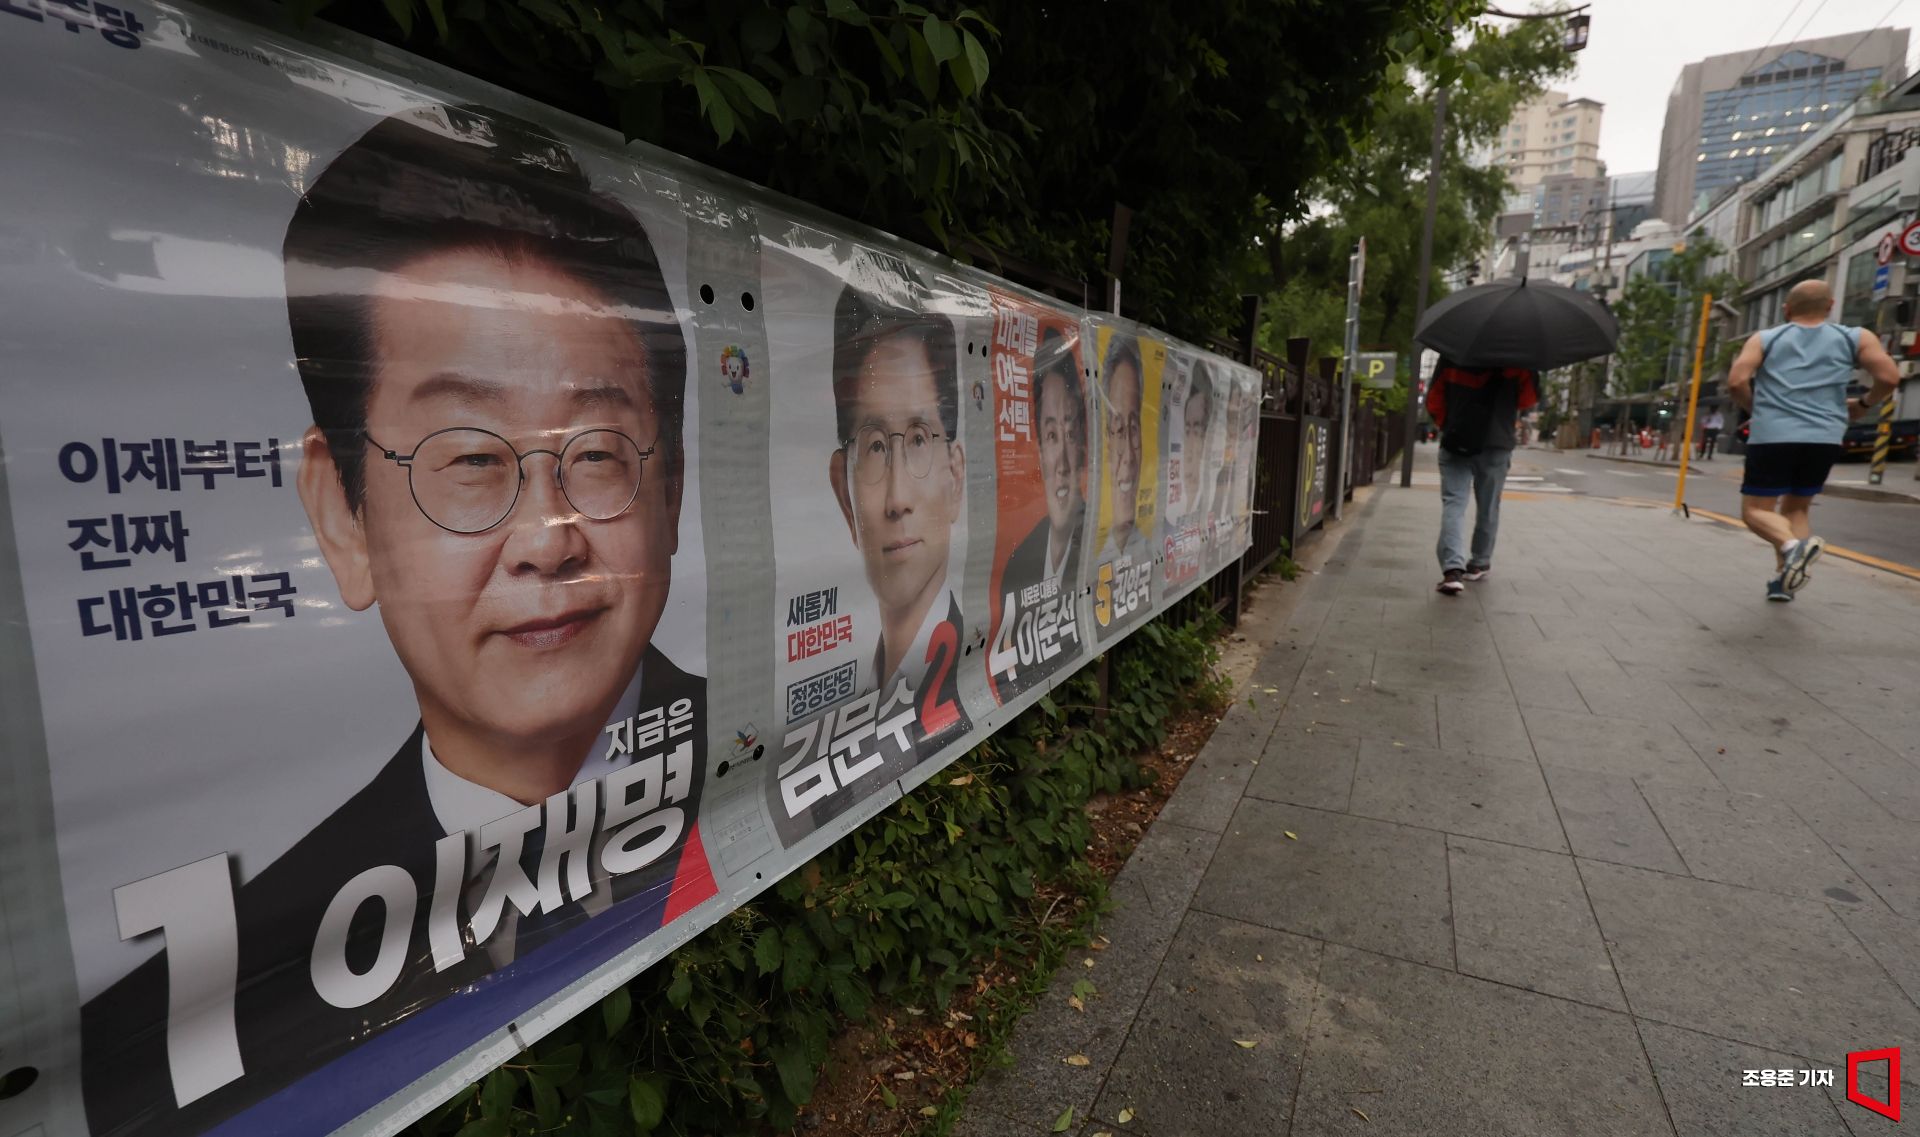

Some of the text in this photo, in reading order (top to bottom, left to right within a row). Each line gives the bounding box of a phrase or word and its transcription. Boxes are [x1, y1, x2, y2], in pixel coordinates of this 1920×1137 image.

[996, 308, 1039, 358] 미래를
[996, 352, 1029, 399] 여는
[1369, 359, 1385, 379] P
[1000, 398, 1032, 443] 선택
[58, 437, 282, 494] 이제부터
[67, 510, 189, 571] 진짜
[77, 571, 297, 641] 대한민국
[787, 586, 838, 627] 새롭게
[1095, 560, 1151, 628] 5 권영국
[787, 615, 853, 663] 대한민국
[989, 590, 1078, 682] 4 이준석
[791, 666, 854, 716] 정정당당
[604, 697, 694, 761] 지금은
[777, 620, 962, 820] 김문수 2
[112, 739, 694, 1110] 1 이재명
